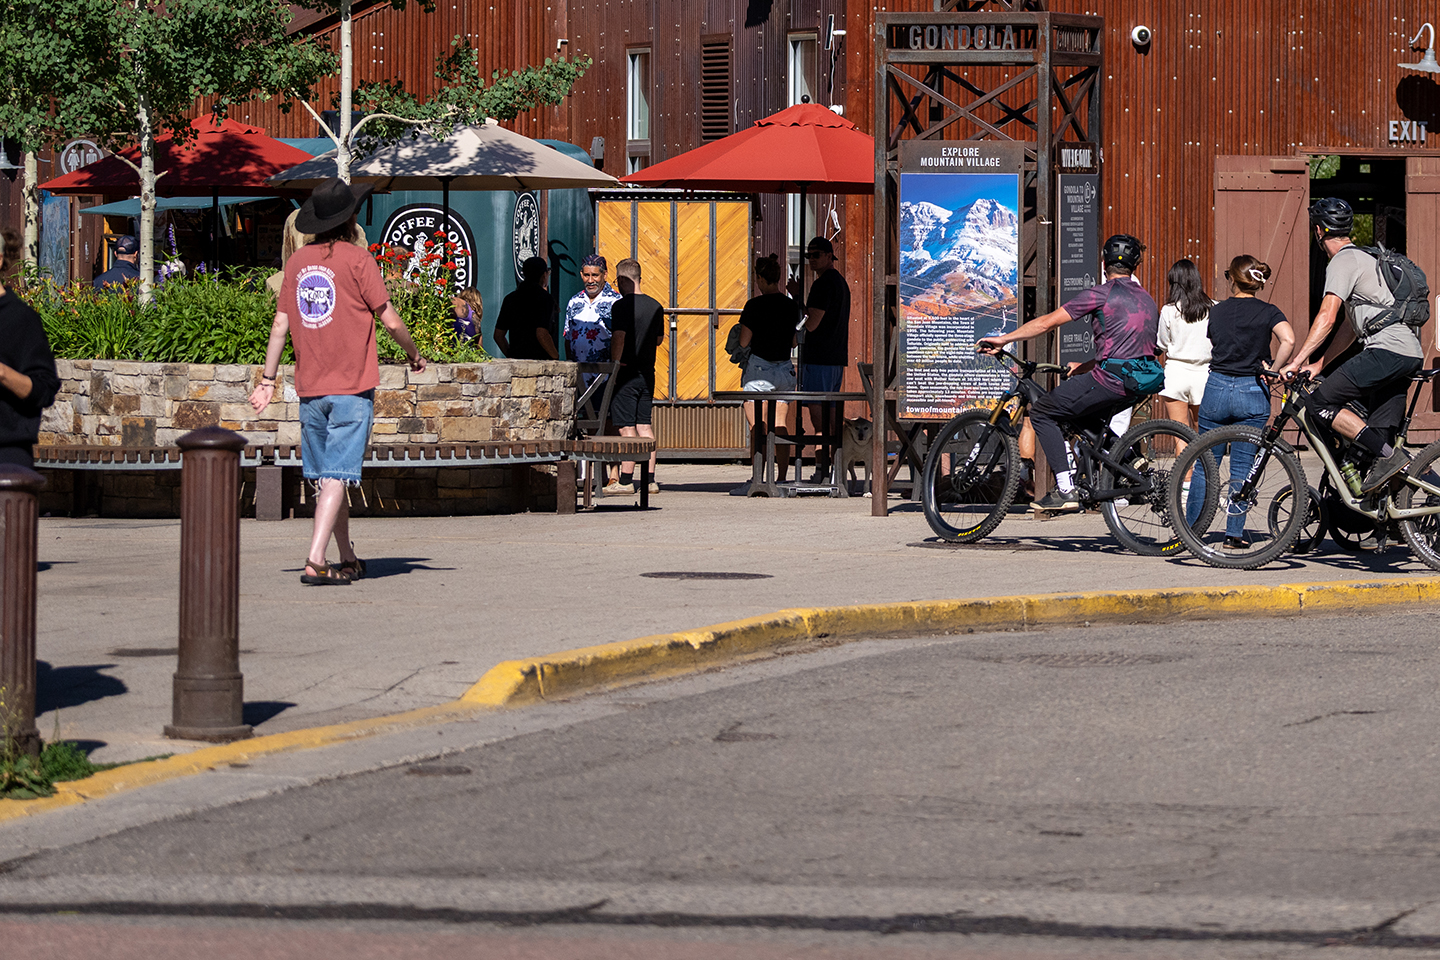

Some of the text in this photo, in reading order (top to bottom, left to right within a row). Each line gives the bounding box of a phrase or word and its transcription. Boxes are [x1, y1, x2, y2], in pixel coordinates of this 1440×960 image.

[908, 24, 1016, 50] GONDOLA
[1389, 120, 1428, 141] EXIT
[941, 147, 980, 158] EXPLORE
[1061, 148, 1093, 168] WELCOME
[920, 157, 1001, 168] MOUNTAIN VILLAGE
[1064, 185, 1079, 194] GONDOLA
[515, 199, 530, 224] COFFEE
[1070, 204, 1084, 213] VILLAGE
[1063, 334, 1083, 342] RIVER TRAIL
[1161, 541, 1182, 552] XXIS
